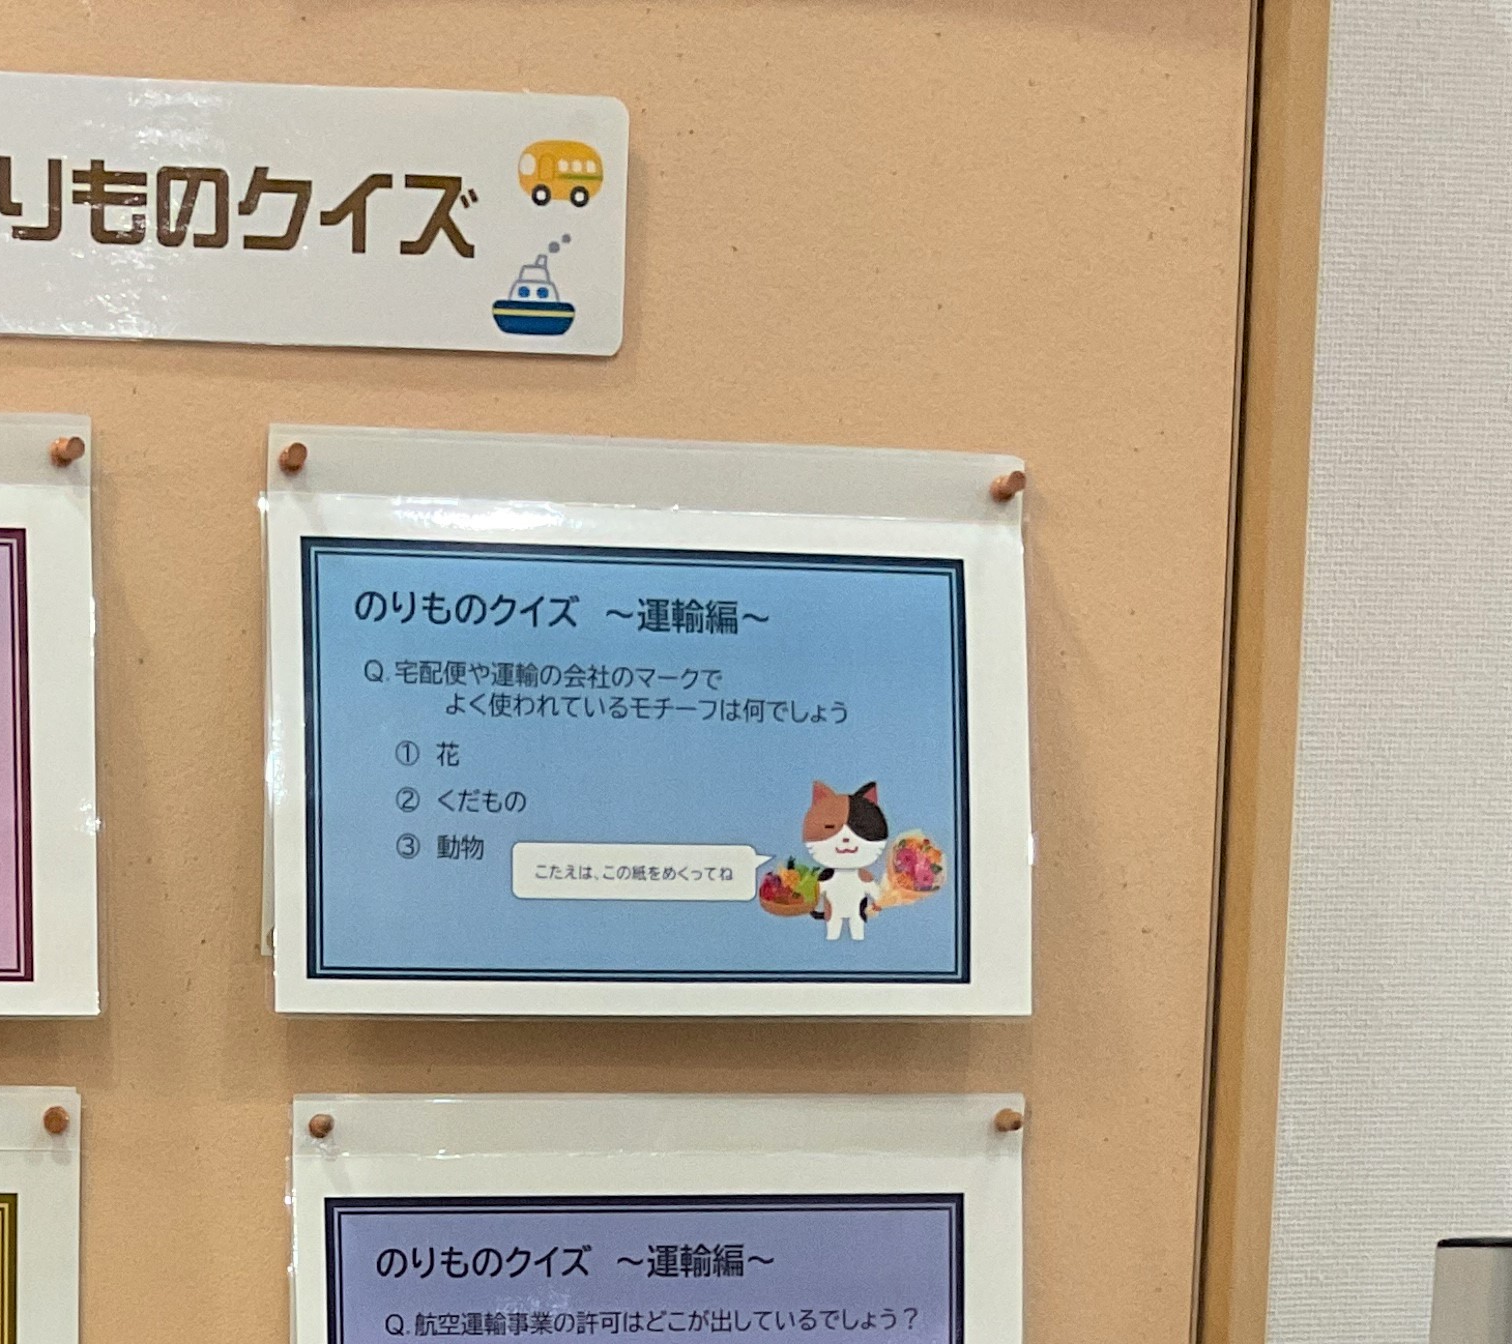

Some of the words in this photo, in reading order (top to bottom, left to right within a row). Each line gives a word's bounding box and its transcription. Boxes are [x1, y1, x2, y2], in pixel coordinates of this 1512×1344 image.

[353, 590, 581, 628] のりものクイズ
[445, 693, 849, 725] よく使われているモチーフは何でしょう
[435, 741, 461, 768] 花
[437, 788, 528, 815] くだもの
[436, 833, 485, 861] 動物
[533, 862, 735, 884] こたえは、この紙をめくってね
[375, 1245, 592, 1280] のりものクイズ
